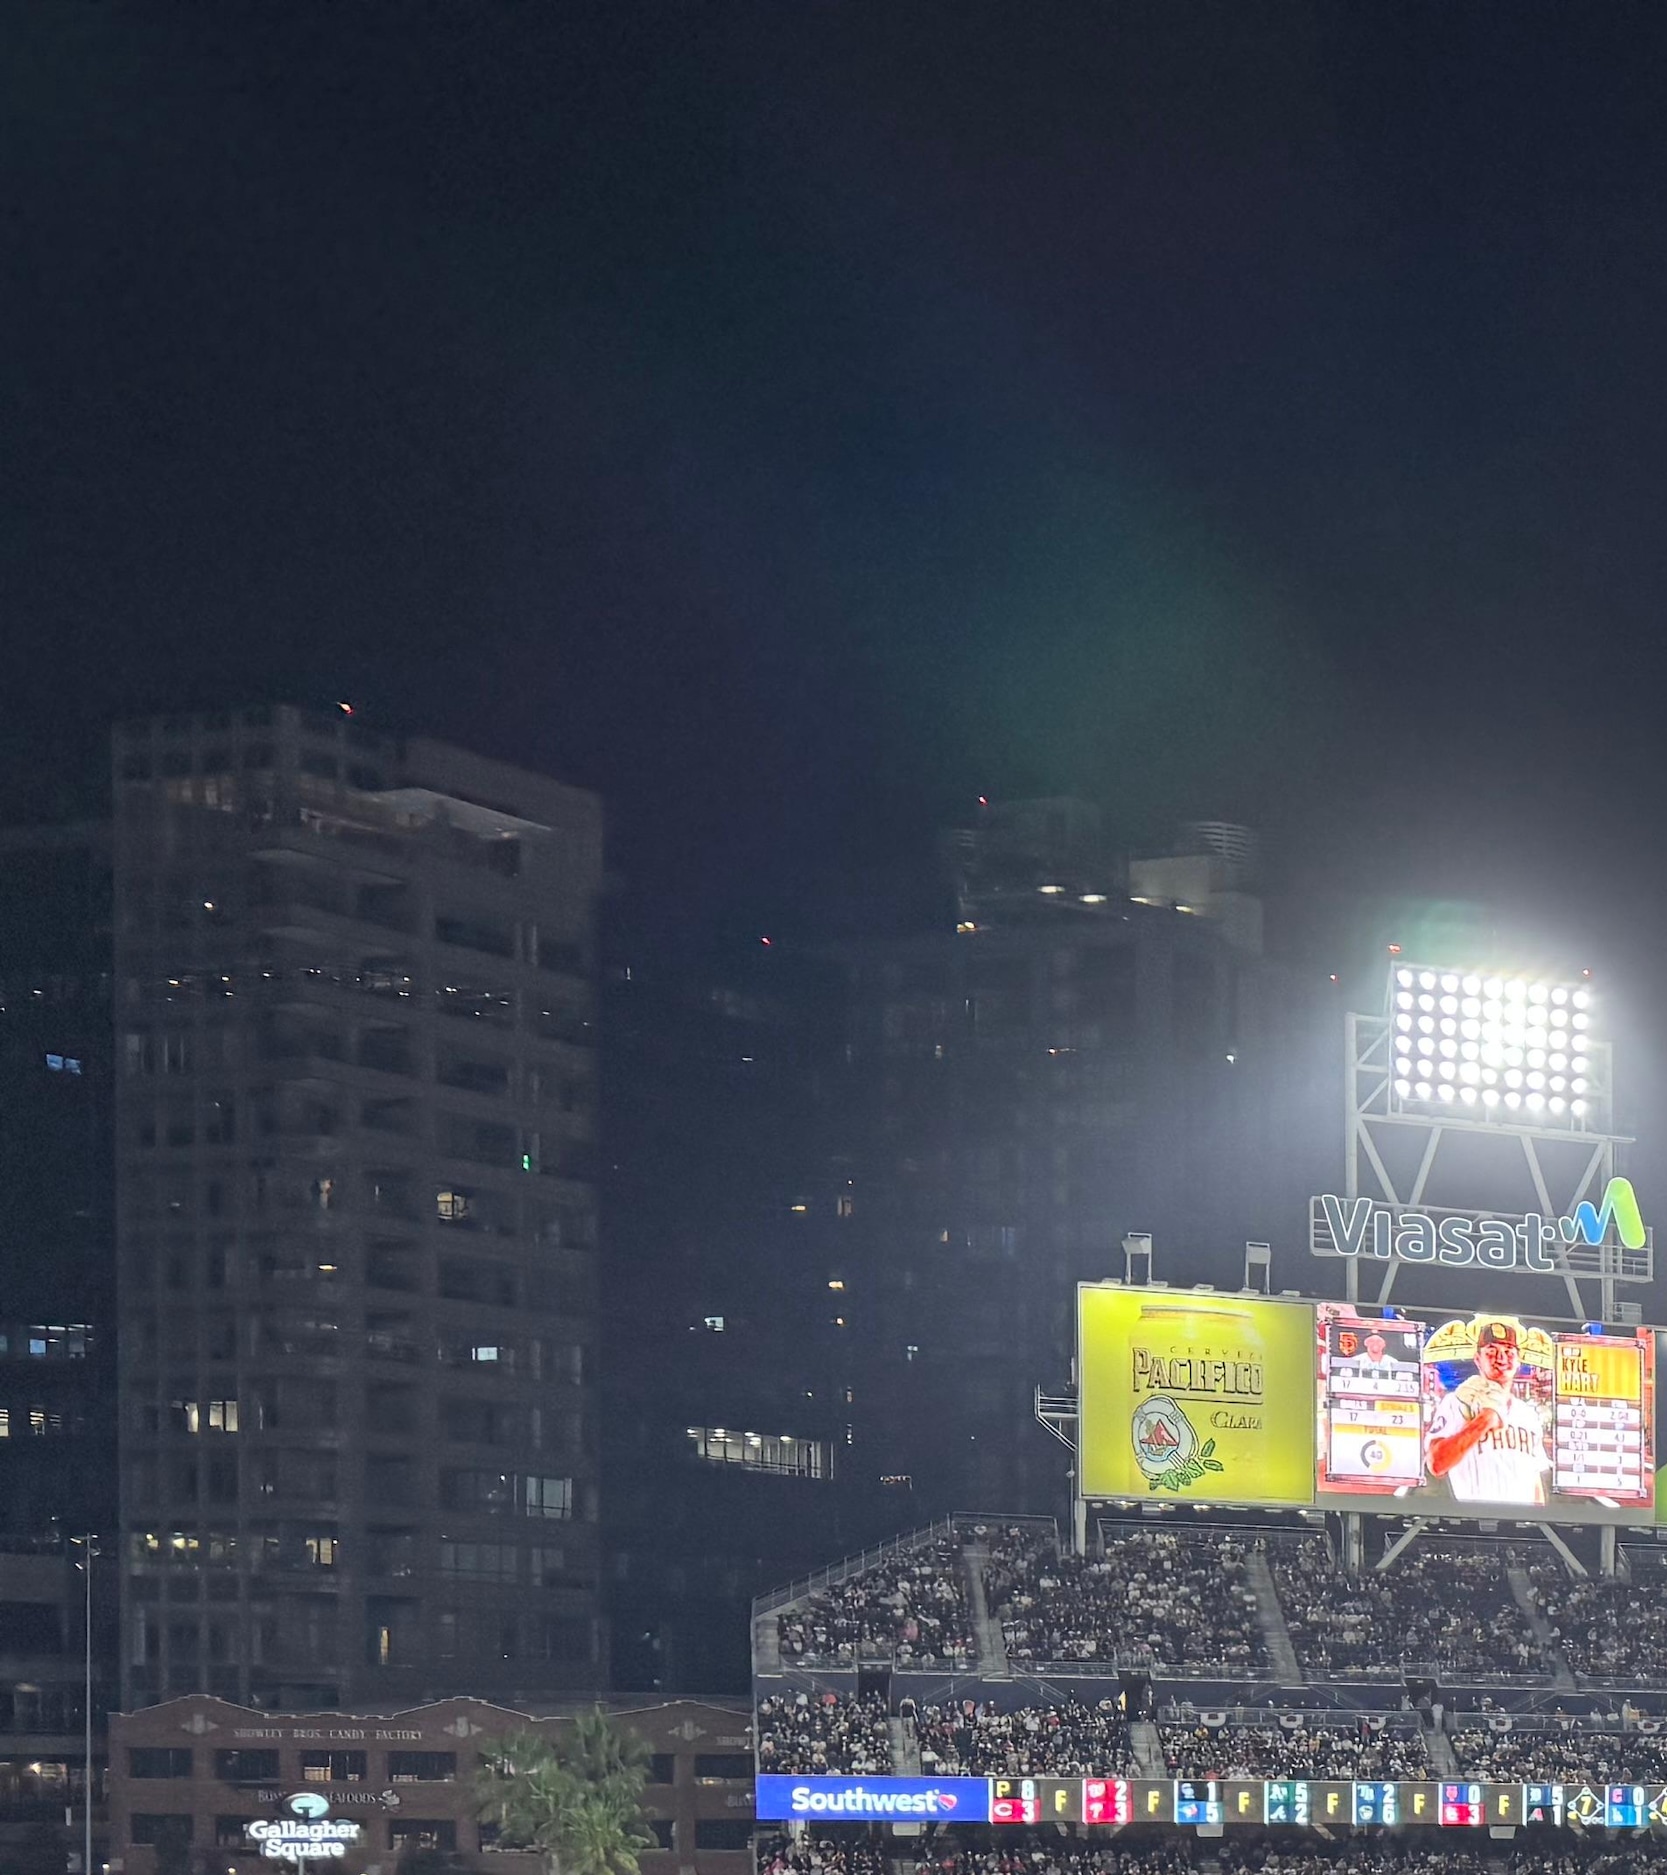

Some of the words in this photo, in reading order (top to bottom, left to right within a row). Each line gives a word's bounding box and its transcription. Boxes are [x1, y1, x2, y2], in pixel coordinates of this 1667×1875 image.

[1321, 1194, 1554, 1272] Viasat
[1132, 1347, 1263, 1395] PACIFICO
[1562, 1359, 1588, 1373] KYLE
[1561, 1373, 1599, 1393] HART
[1392, 1415, 1404, 1425] 23
[329, 1729, 365, 1740] CANDY
[376, 1730, 422, 1741] FACTORY
[792, 1786, 937, 1812] Southwest
[1021, 1781, 1034, 1799] 8
[1055, 1790, 1066, 1812] F
[1115, 1781, 1127, 1800] 2
[1148, 1791, 1160, 1812] F
[1208, 1781, 1217, 1800] 1
[1239, 1792, 1250, 1813] F
[1295, 1782, 1308, 1801] 5
[1327, 1793, 1339, 1814] F
[1383, 1784, 1395, 1803] 2
[1414, 1794, 1425, 1815] F
[1468, 1785, 1480, 1804] 0
[1499, 1795, 1510, 1816] F
[1552, 1786, 1563, 1805] 5
[1580, 1796, 1590, 1816] 7
[1632, 1786, 1645, 1805] 0
[1021, 1801, 1034, 1820] 3
[1115, 1801, 1127, 1821] 3
[1206, 1802, 1219, 1822] 5
[1295, 1802, 1308, 1822] 2
[1383, 1803, 1395, 1823] 6
[1468, 1804, 1480, 1824] 3
[1554, 1806, 1562, 1826] 1
[1634, 1806, 1643, 1826] 1
[249, 1819, 360, 1841] Gallagher
[265, 1839, 345, 1863] Square
